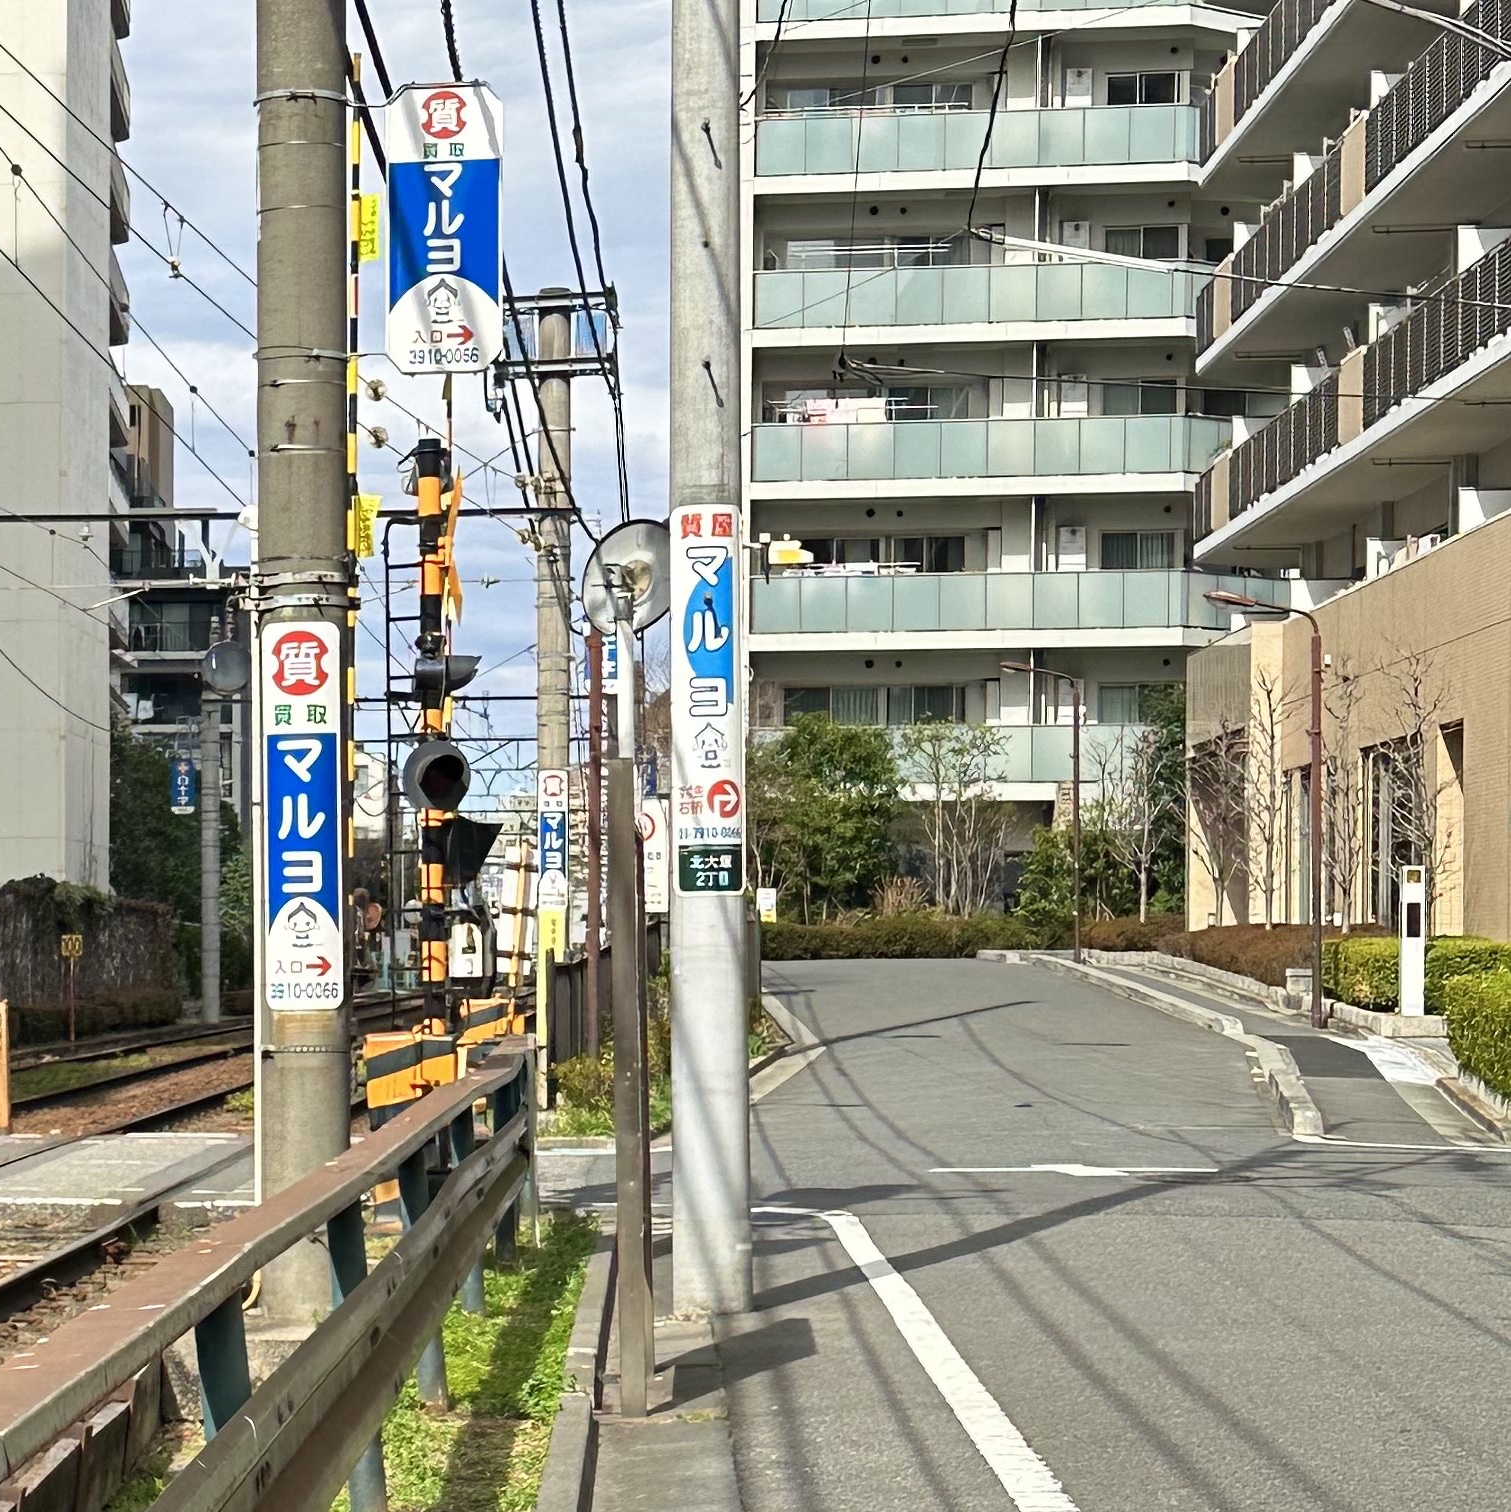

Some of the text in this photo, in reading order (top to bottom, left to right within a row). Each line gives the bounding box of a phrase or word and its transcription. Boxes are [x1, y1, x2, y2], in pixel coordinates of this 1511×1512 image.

[427, 98, 461, 133] 質
[423, 162, 465, 273] マルヨ
[412, 330, 442, 344] 入口
[686, 546, 729, 717] マルヨ
[280, 641, 321, 687] 質
[274, 704, 327, 726] 買取
[276, 739, 326, 893] マルヨ
[543, 812, 564, 869] マルヨ
[274, 959, 303, 974] 入口
